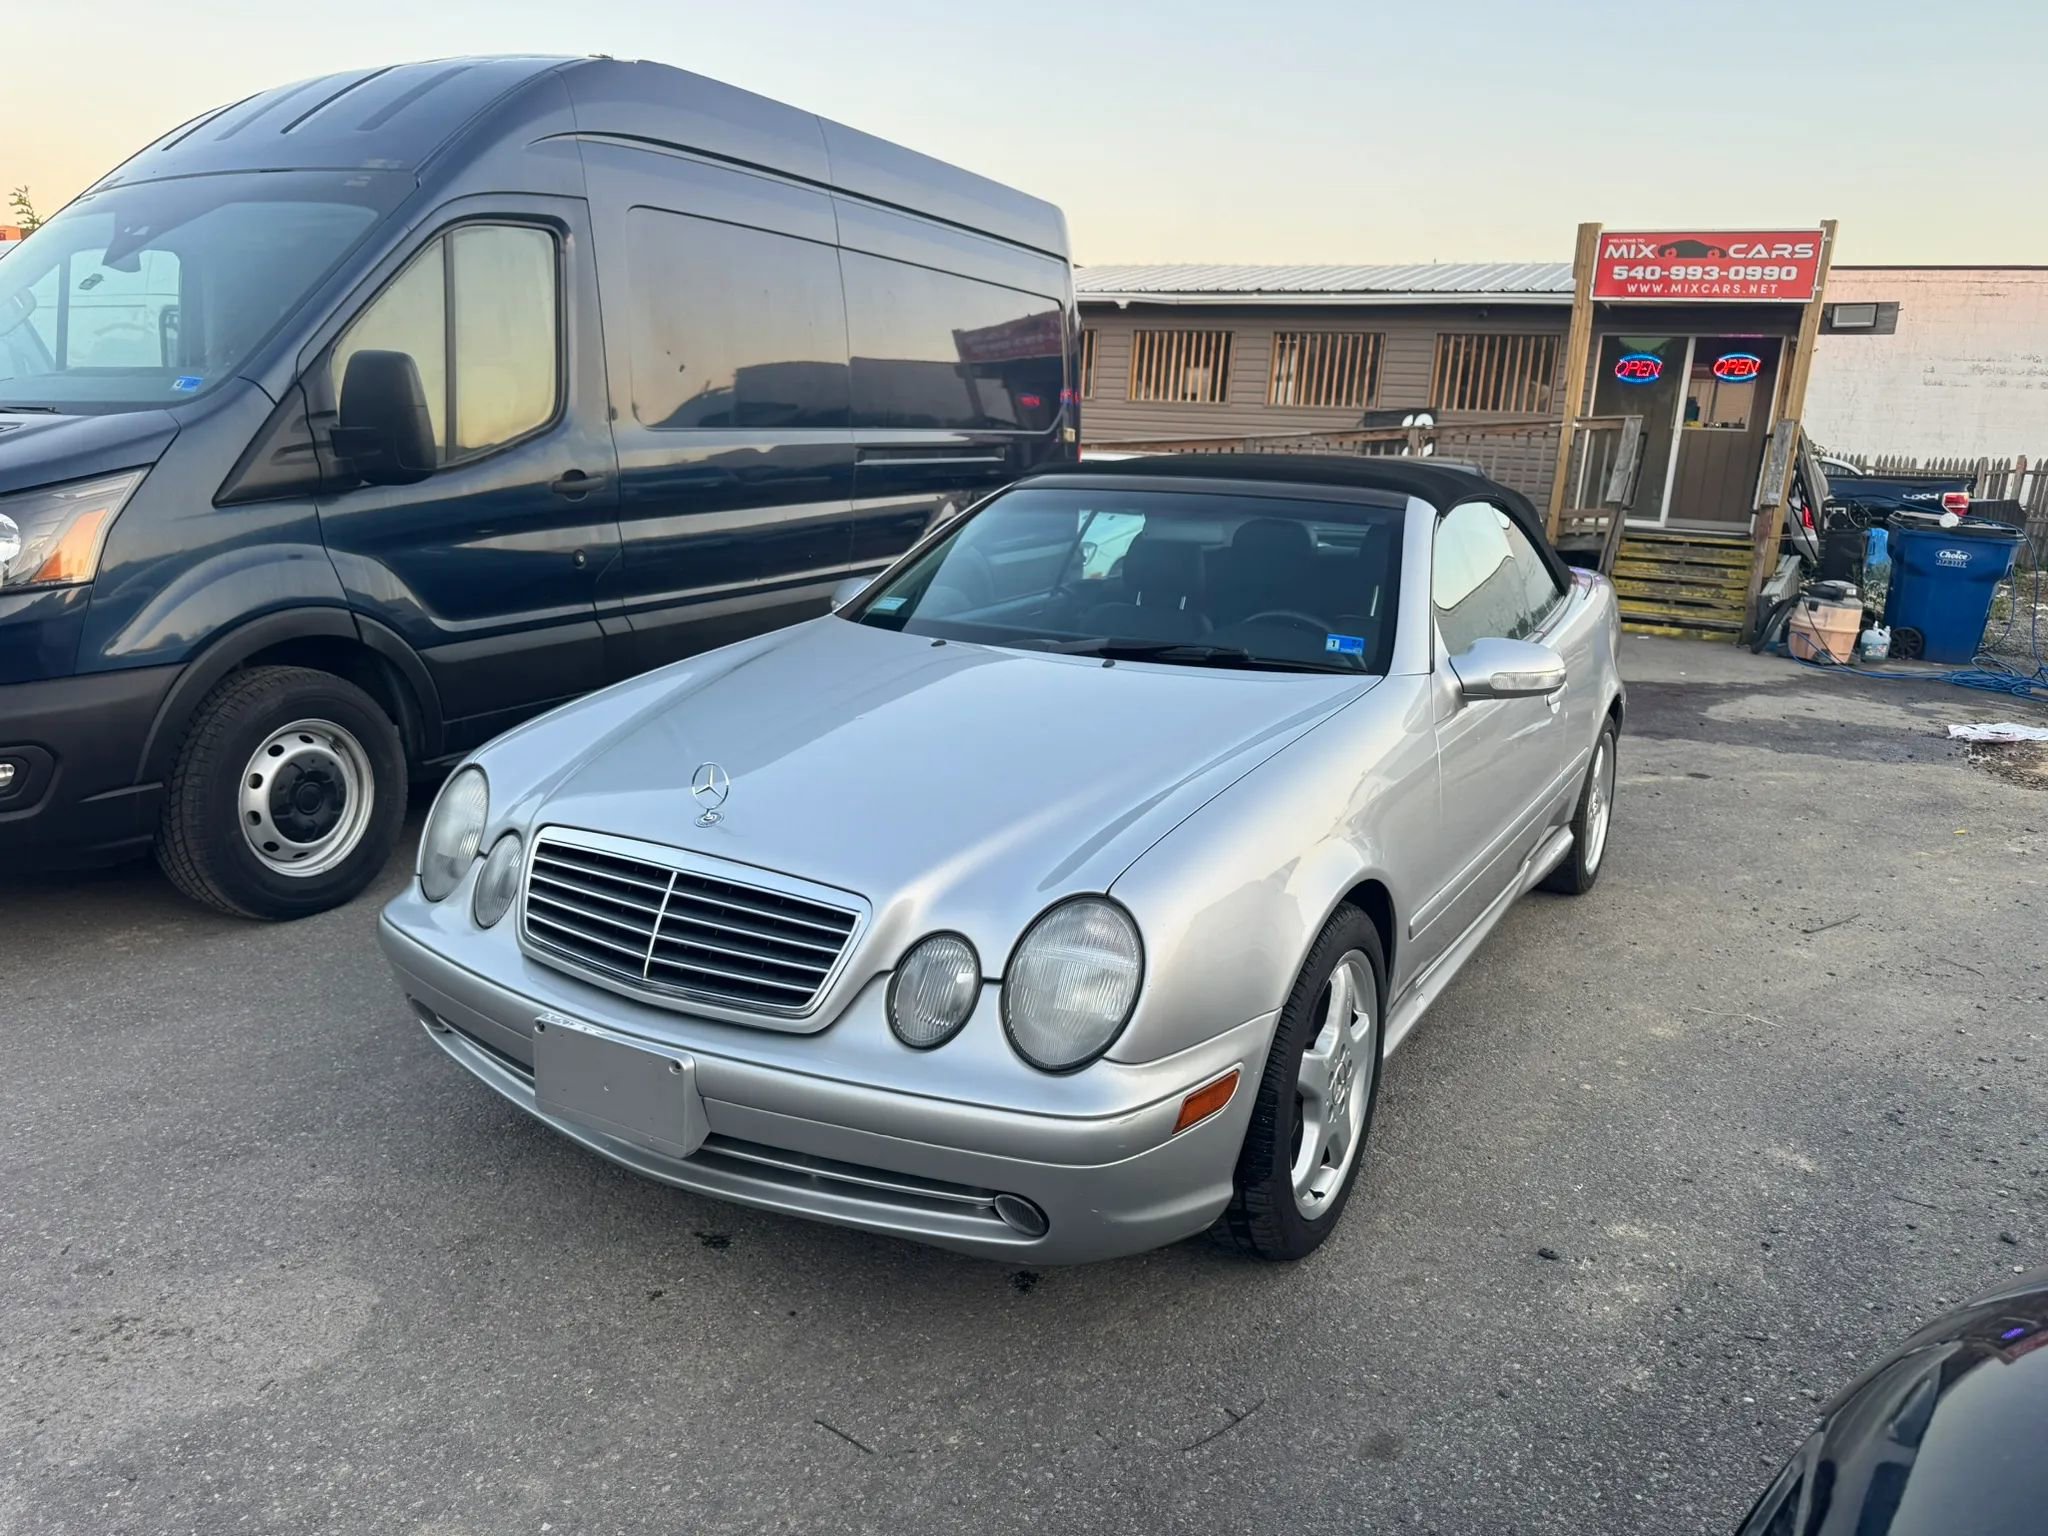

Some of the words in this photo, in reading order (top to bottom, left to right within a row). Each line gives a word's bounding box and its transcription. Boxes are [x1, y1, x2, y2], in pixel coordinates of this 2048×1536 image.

[1604, 243, 1656, 259] MIX
[1728, 243, 1814, 259] CARS
[1613, 265, 1798, 280] 540-993-0990
[1627, 283, 1778, 294] WWW.MIXCARS.NET
[1615, 361, 1662, 377] OPEN
[1713, 359, 1761, 375] OPEN
